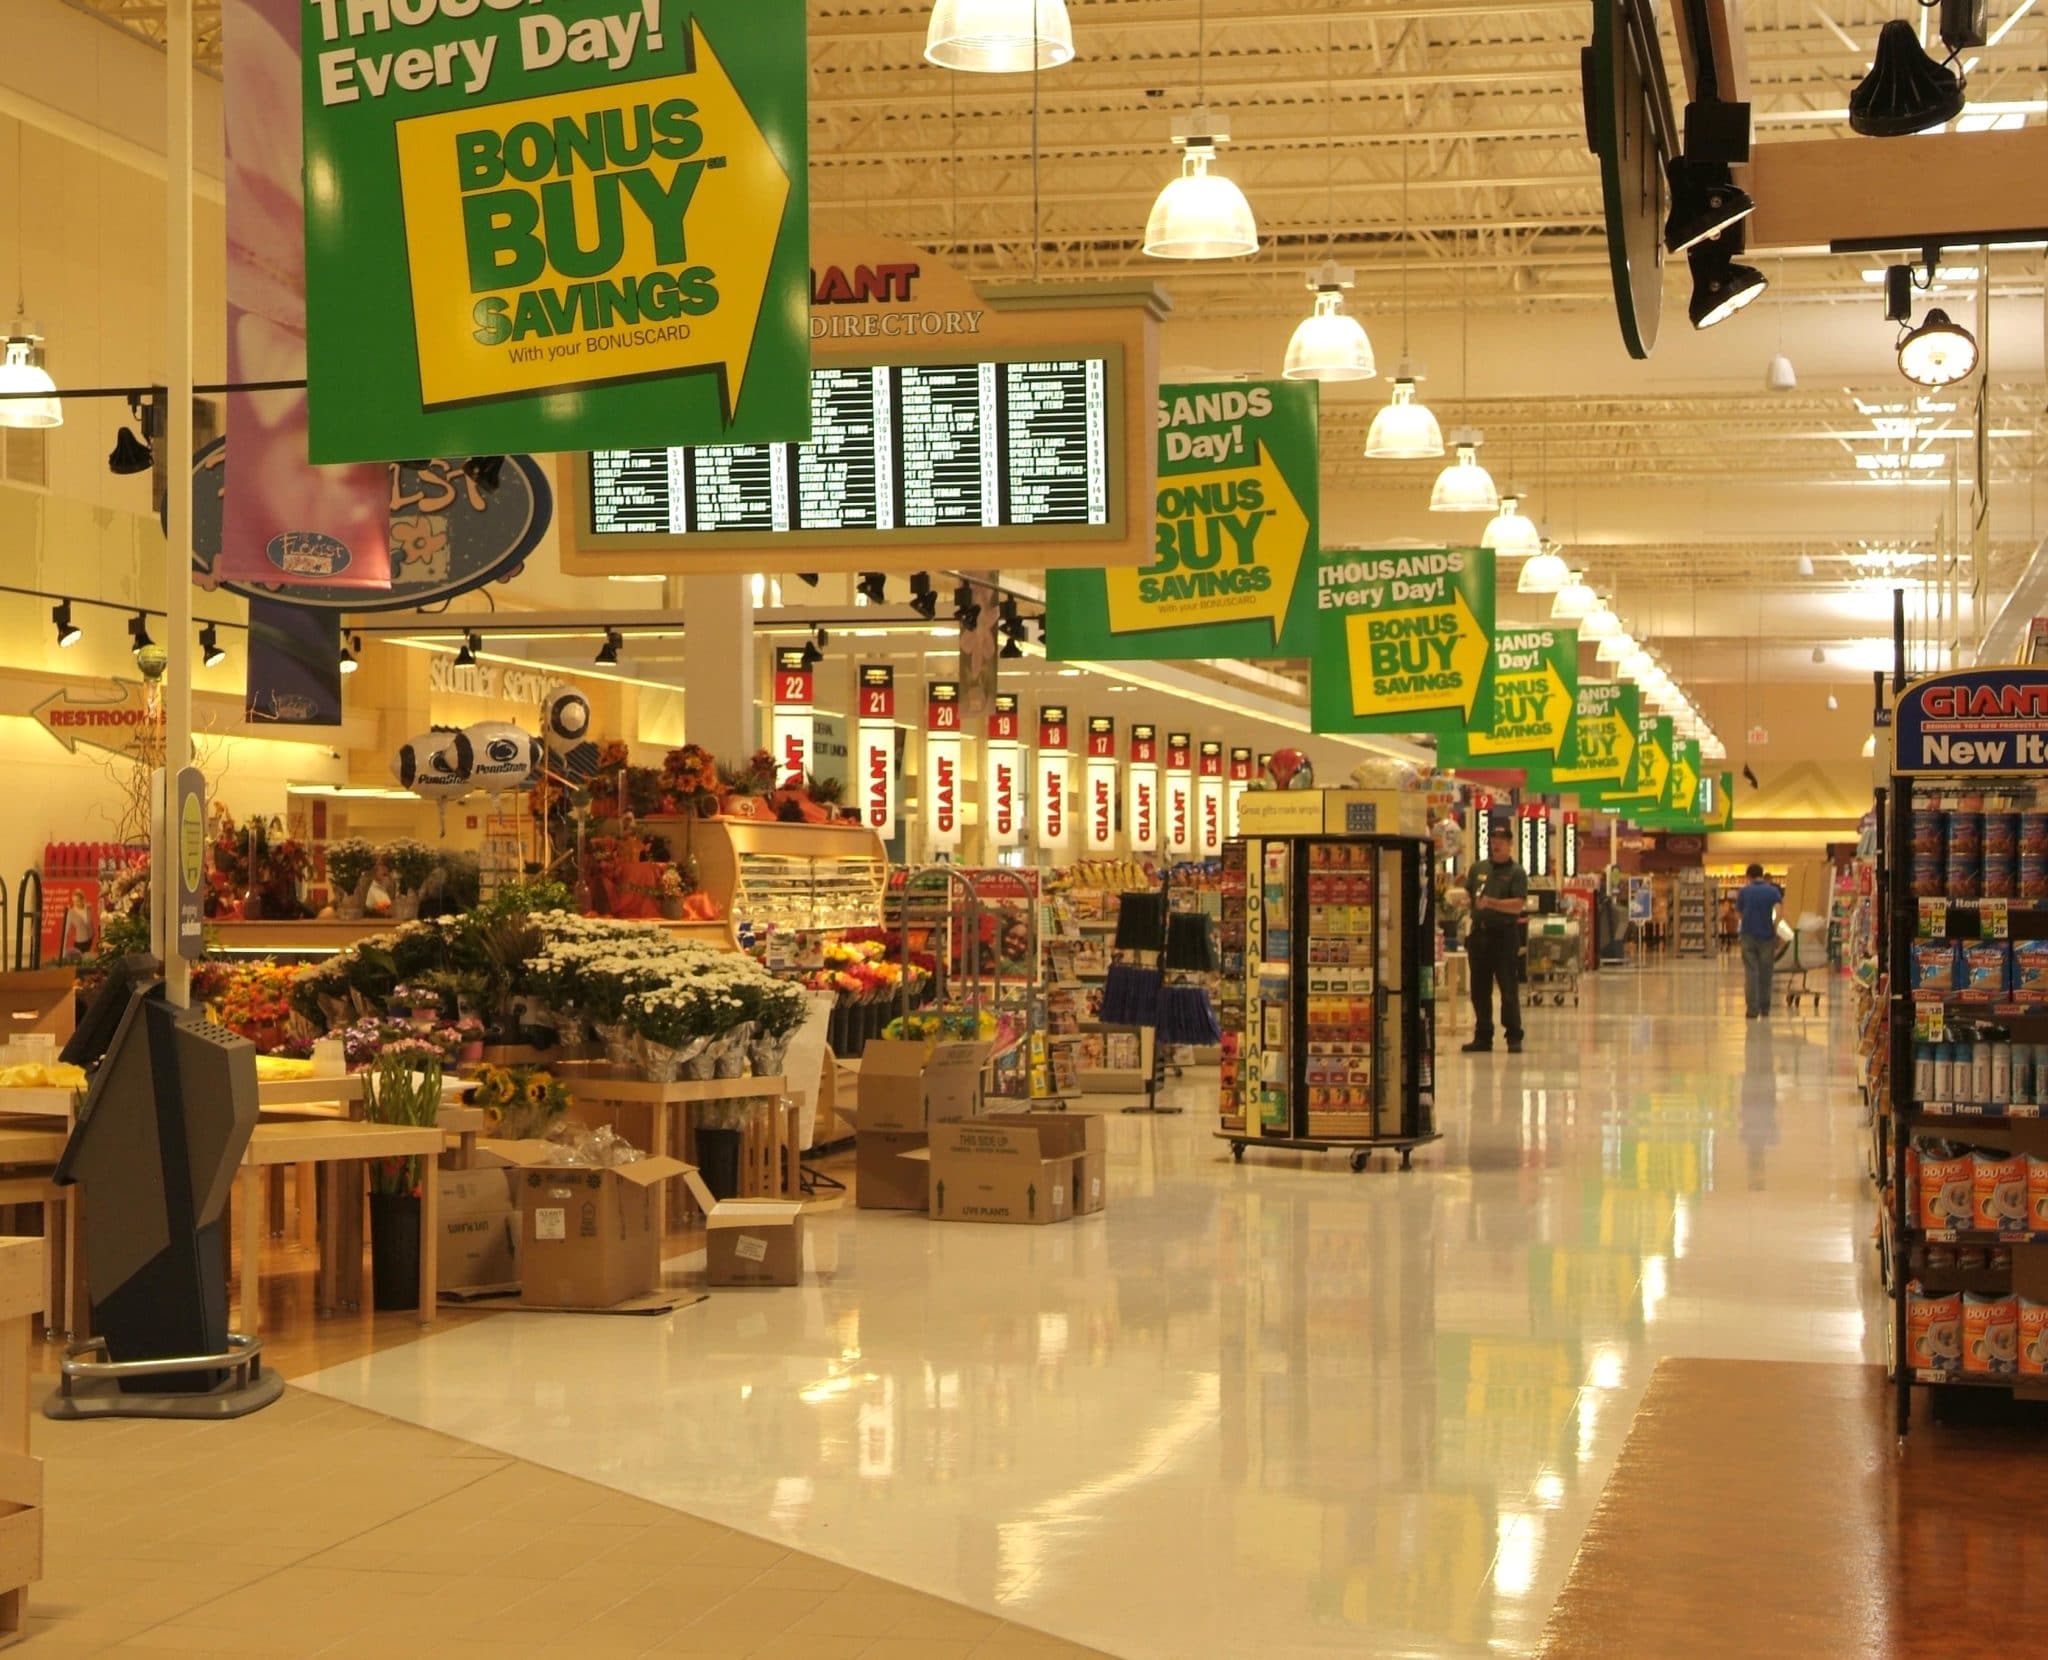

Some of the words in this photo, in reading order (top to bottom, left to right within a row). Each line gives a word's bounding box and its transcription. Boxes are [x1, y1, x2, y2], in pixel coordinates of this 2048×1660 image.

[319, 36, 497, 106] Every
[519, 0, 664, 71] Day!
[456, 98, 704, 192] BONUS
[462, 159, 706, 294] BUY
[811, 263, 920, 305] ANT
[473, 266, 720, 346] SAVINGS
[810, 310, 984, 338] DIRECTORY
[508, 343, 544, 364] With
[548, 340, 581, 362] your
[586, 324, 691, 353] BONUSCARD
[1157, 387, 1273, 429] SANDS
[1166, 425, 1244, 463] Day!
[1138, 510, 1267, 576] BUY
[1138, 566, 1272, 604] SAVINGS
[1318, 552, 1465, 587] THOUSANDS
[1318, 587, 1384, 610] Every
[1392, 577, 1444, 603] Day!
[1368, 612, 1458, 642] BONUS
[1370, 636, 1460, 678] BUY
[1498, 651, 1540, 671] Day!
[786, 676, 804, 699] 22
[870, 691, 886, 713] 21
[1374, 671, 1463, 696] SAVINGS
[1921, 684, 2048, 720] GIANT
[937, 707, 953, 726] 20
[998, 716, 1011, 736] 19
[1049, 727, 1060, 745] 18
[1097, 736, 1107, 754] 17
[1923, 734, 2007, 765] New
[2016, 734, 2048, 764] It
[870, 746, 887, 827] GIANT
[938, 757, 954, 832] GIANT
[997, 764, 1011, 834] GIANT
[1047, 771, 1061, 837] GIANT
[1096, 779, 1109, 842] GIANT
[1139, 784, 1150, 842] GIANT
[1174, 789, 1185, 845] GIANT
[1206, 794, 1217, 847] GIANT
[1249, 873, 1260, 978] LOCAL
[1249, 998, 1260, 1105] STARS
